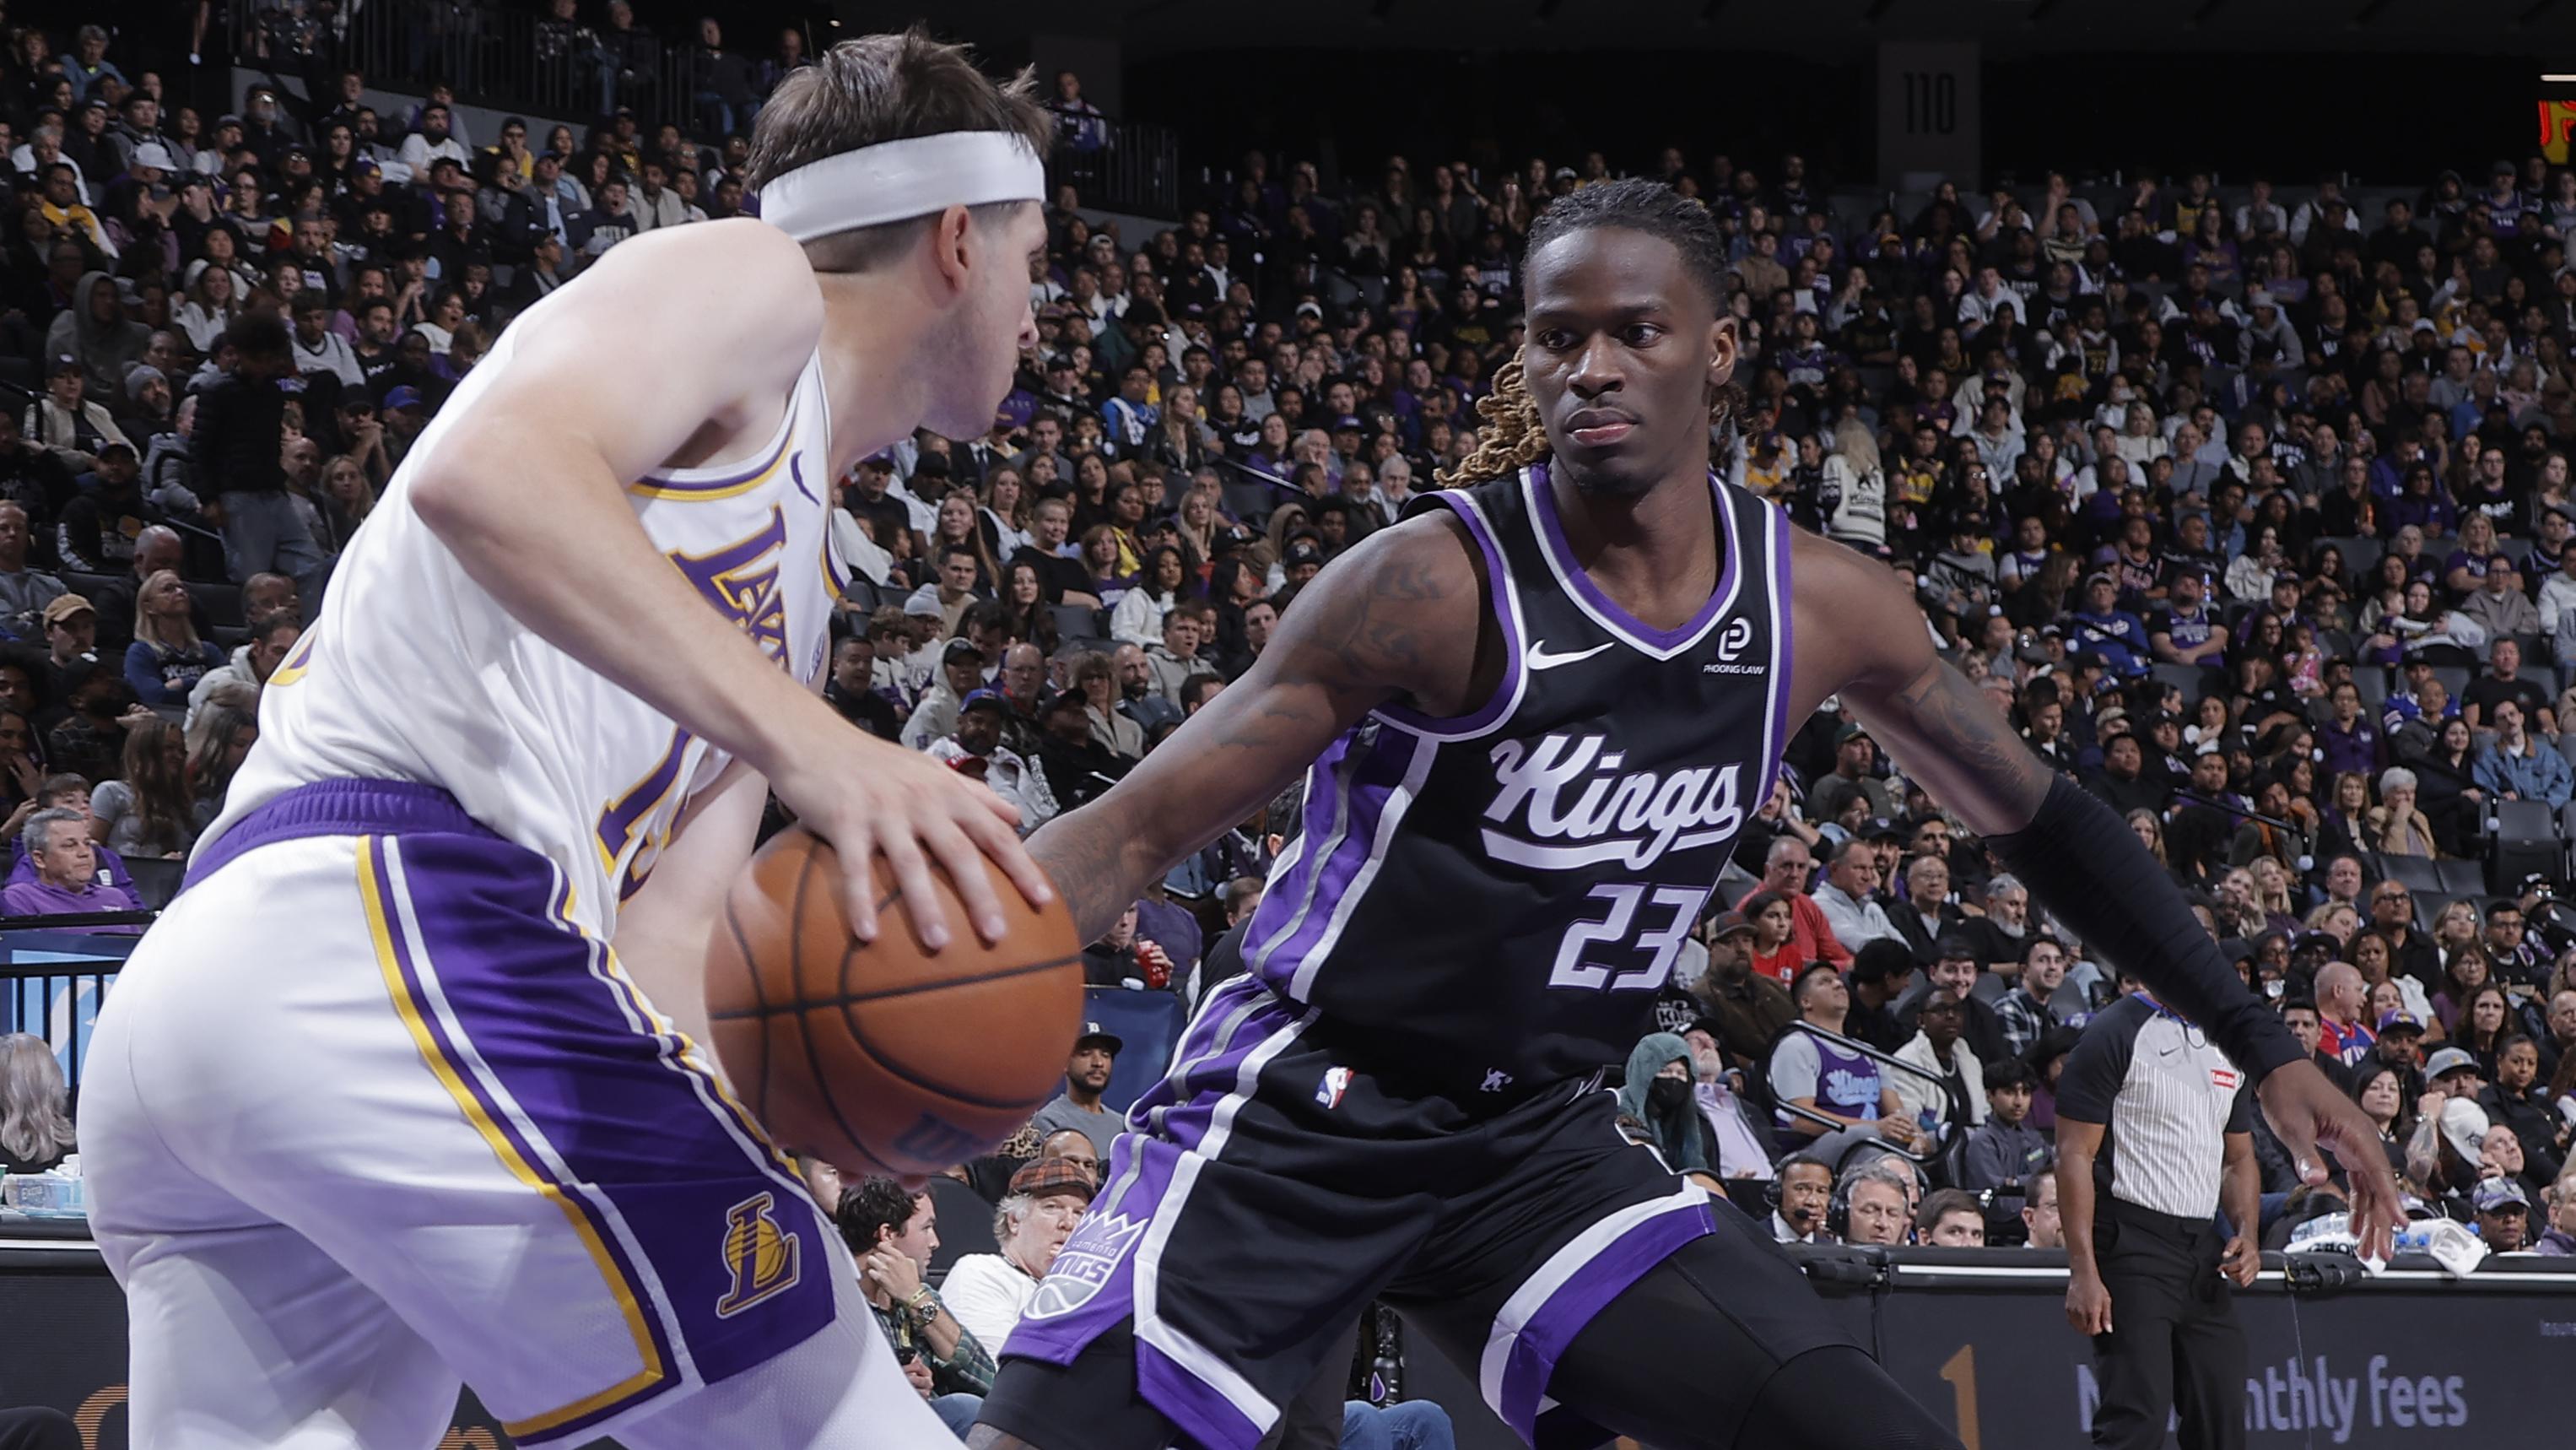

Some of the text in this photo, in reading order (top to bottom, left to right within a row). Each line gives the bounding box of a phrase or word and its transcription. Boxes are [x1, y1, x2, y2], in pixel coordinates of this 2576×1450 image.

[1904, 73, 1956, 136] 110
[1703, 663, 1764, 675] PHOONG LAW
[1482, 733, 1744, 871] Kings
[1546, 882, 1712, 993] 23
[716, 1191, 801, 1319] L
[1050, 1254, 1111, 1285] NGS
[1939, 1344, 1980, 1450] 1
[2368, 1354, 2469, 1428] fees
